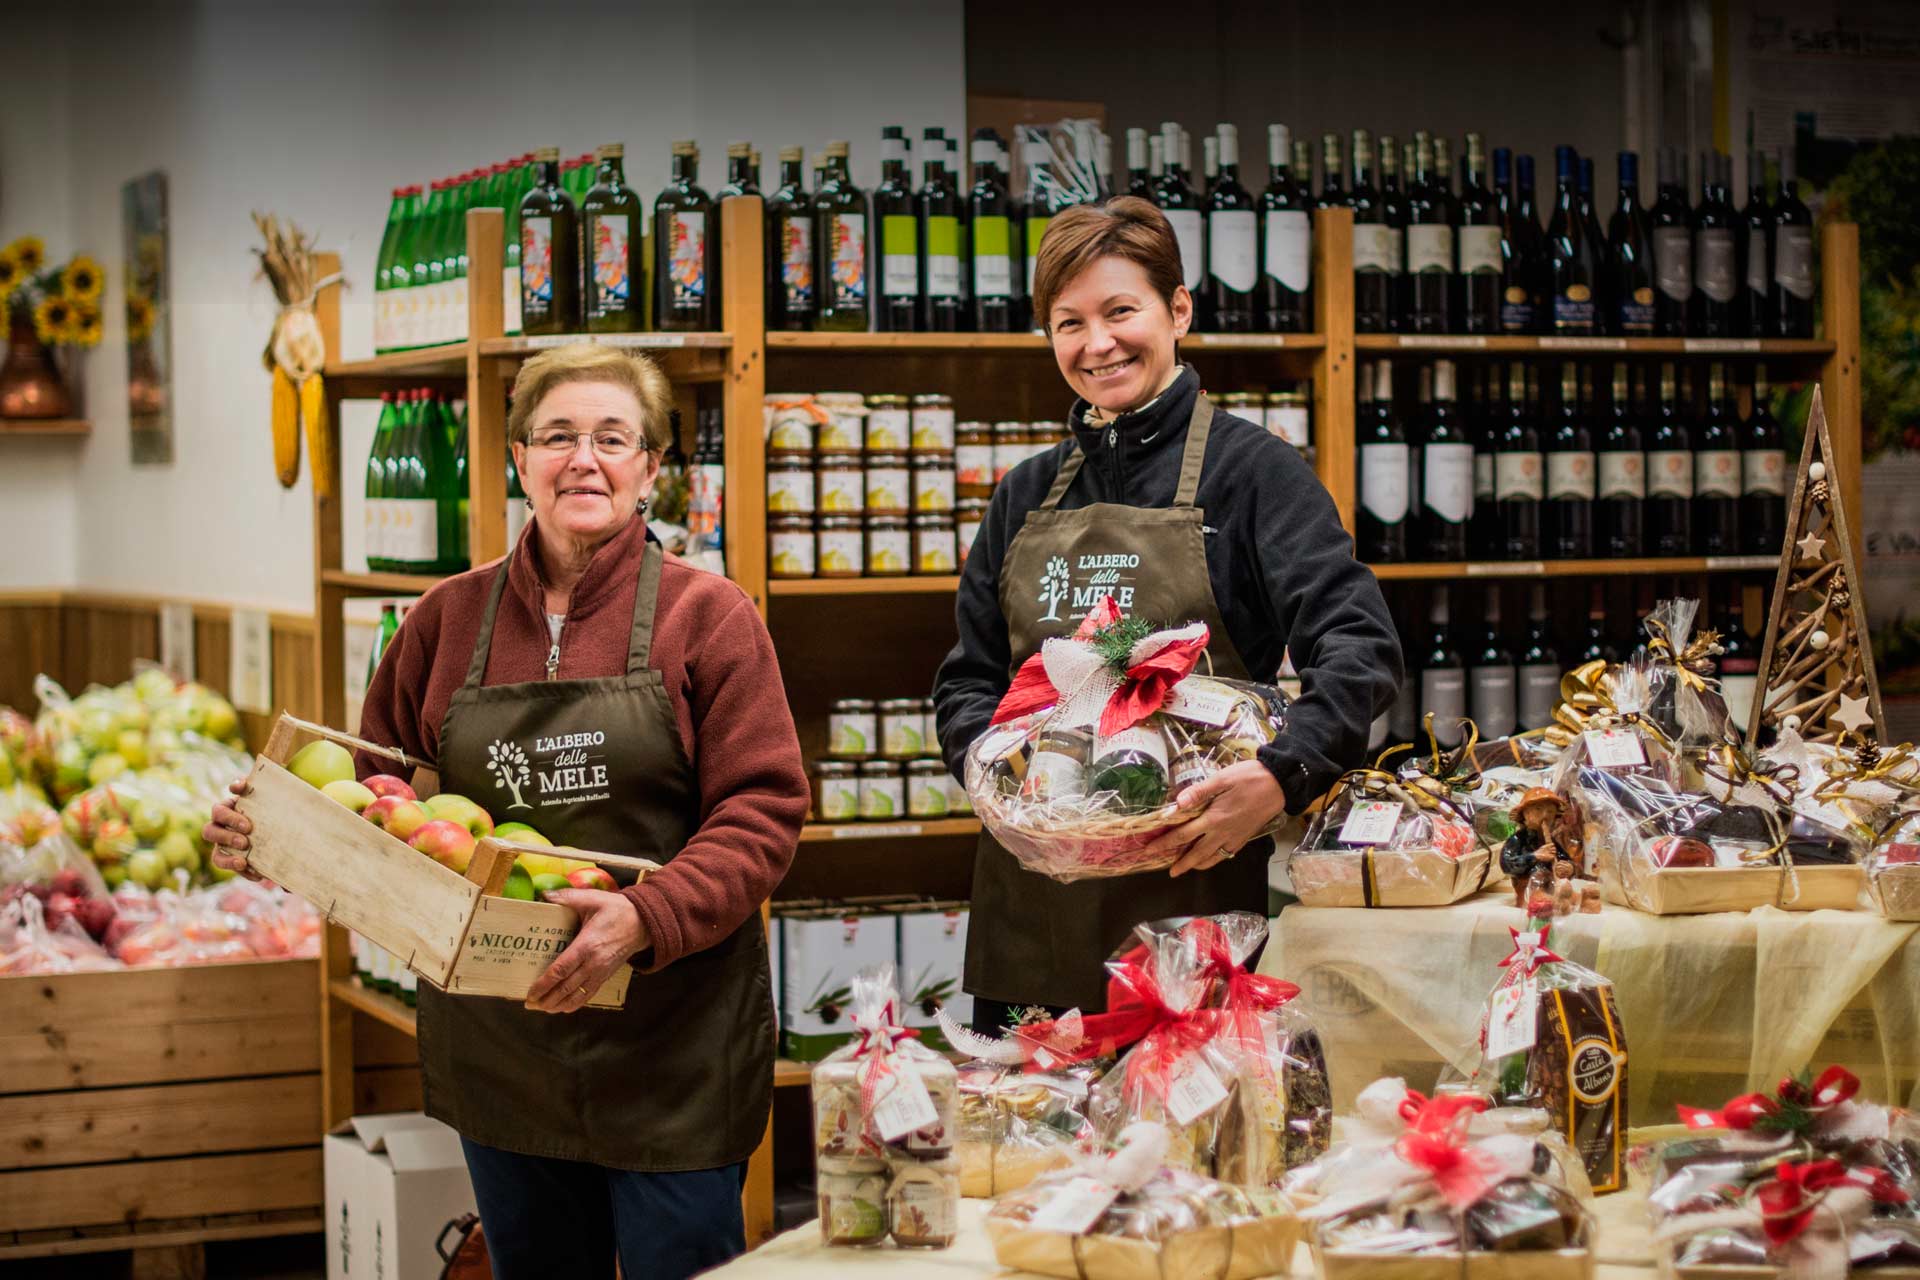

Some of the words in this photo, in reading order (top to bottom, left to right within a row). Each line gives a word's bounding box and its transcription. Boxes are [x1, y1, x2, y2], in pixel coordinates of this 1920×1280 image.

[1078, 554, 1140, 569] L'ALBERO
[1089, 568, 1121, 584] delle
[535, 730, 605, 753] L'ALBERO
[554, 748, 588, 767] delle
[537, 764, 609, 793] MELE
[544, 927, 578, 937] AGRIC
[479, 932, 553, 952] NICOLIS
